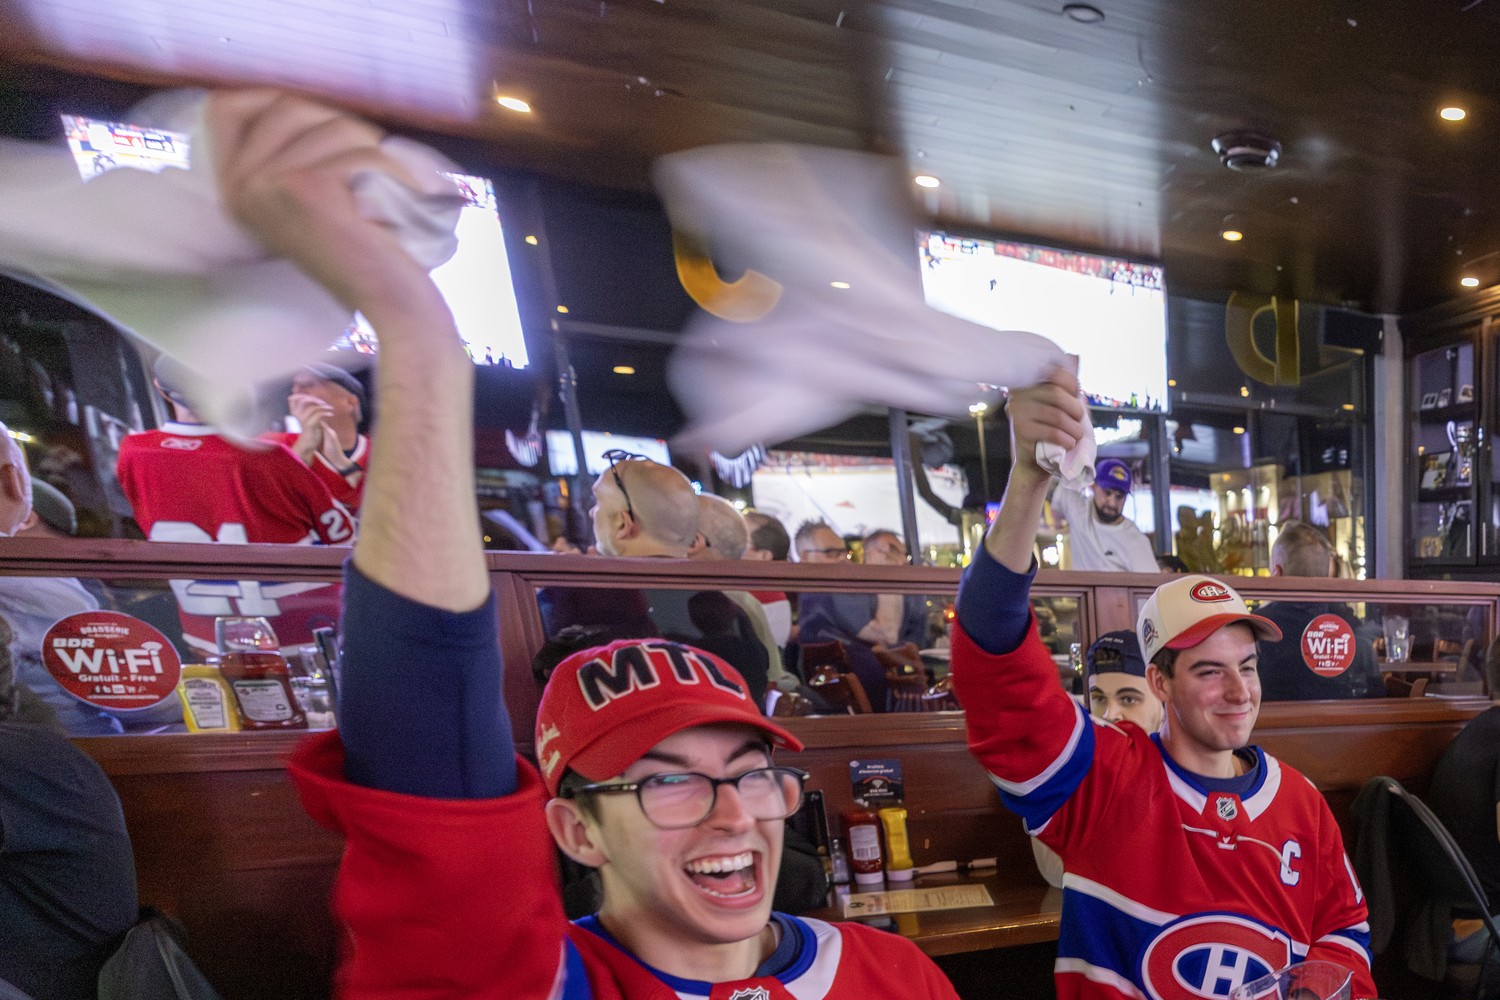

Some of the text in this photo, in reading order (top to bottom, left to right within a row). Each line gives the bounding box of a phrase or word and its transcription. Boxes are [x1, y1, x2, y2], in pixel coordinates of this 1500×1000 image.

[52, 638, 95, 649] BDR
[130, 673, 157, 683] Free
[577, 642, 746, 712] MTL
[1280, 838, 1301, 888] C
